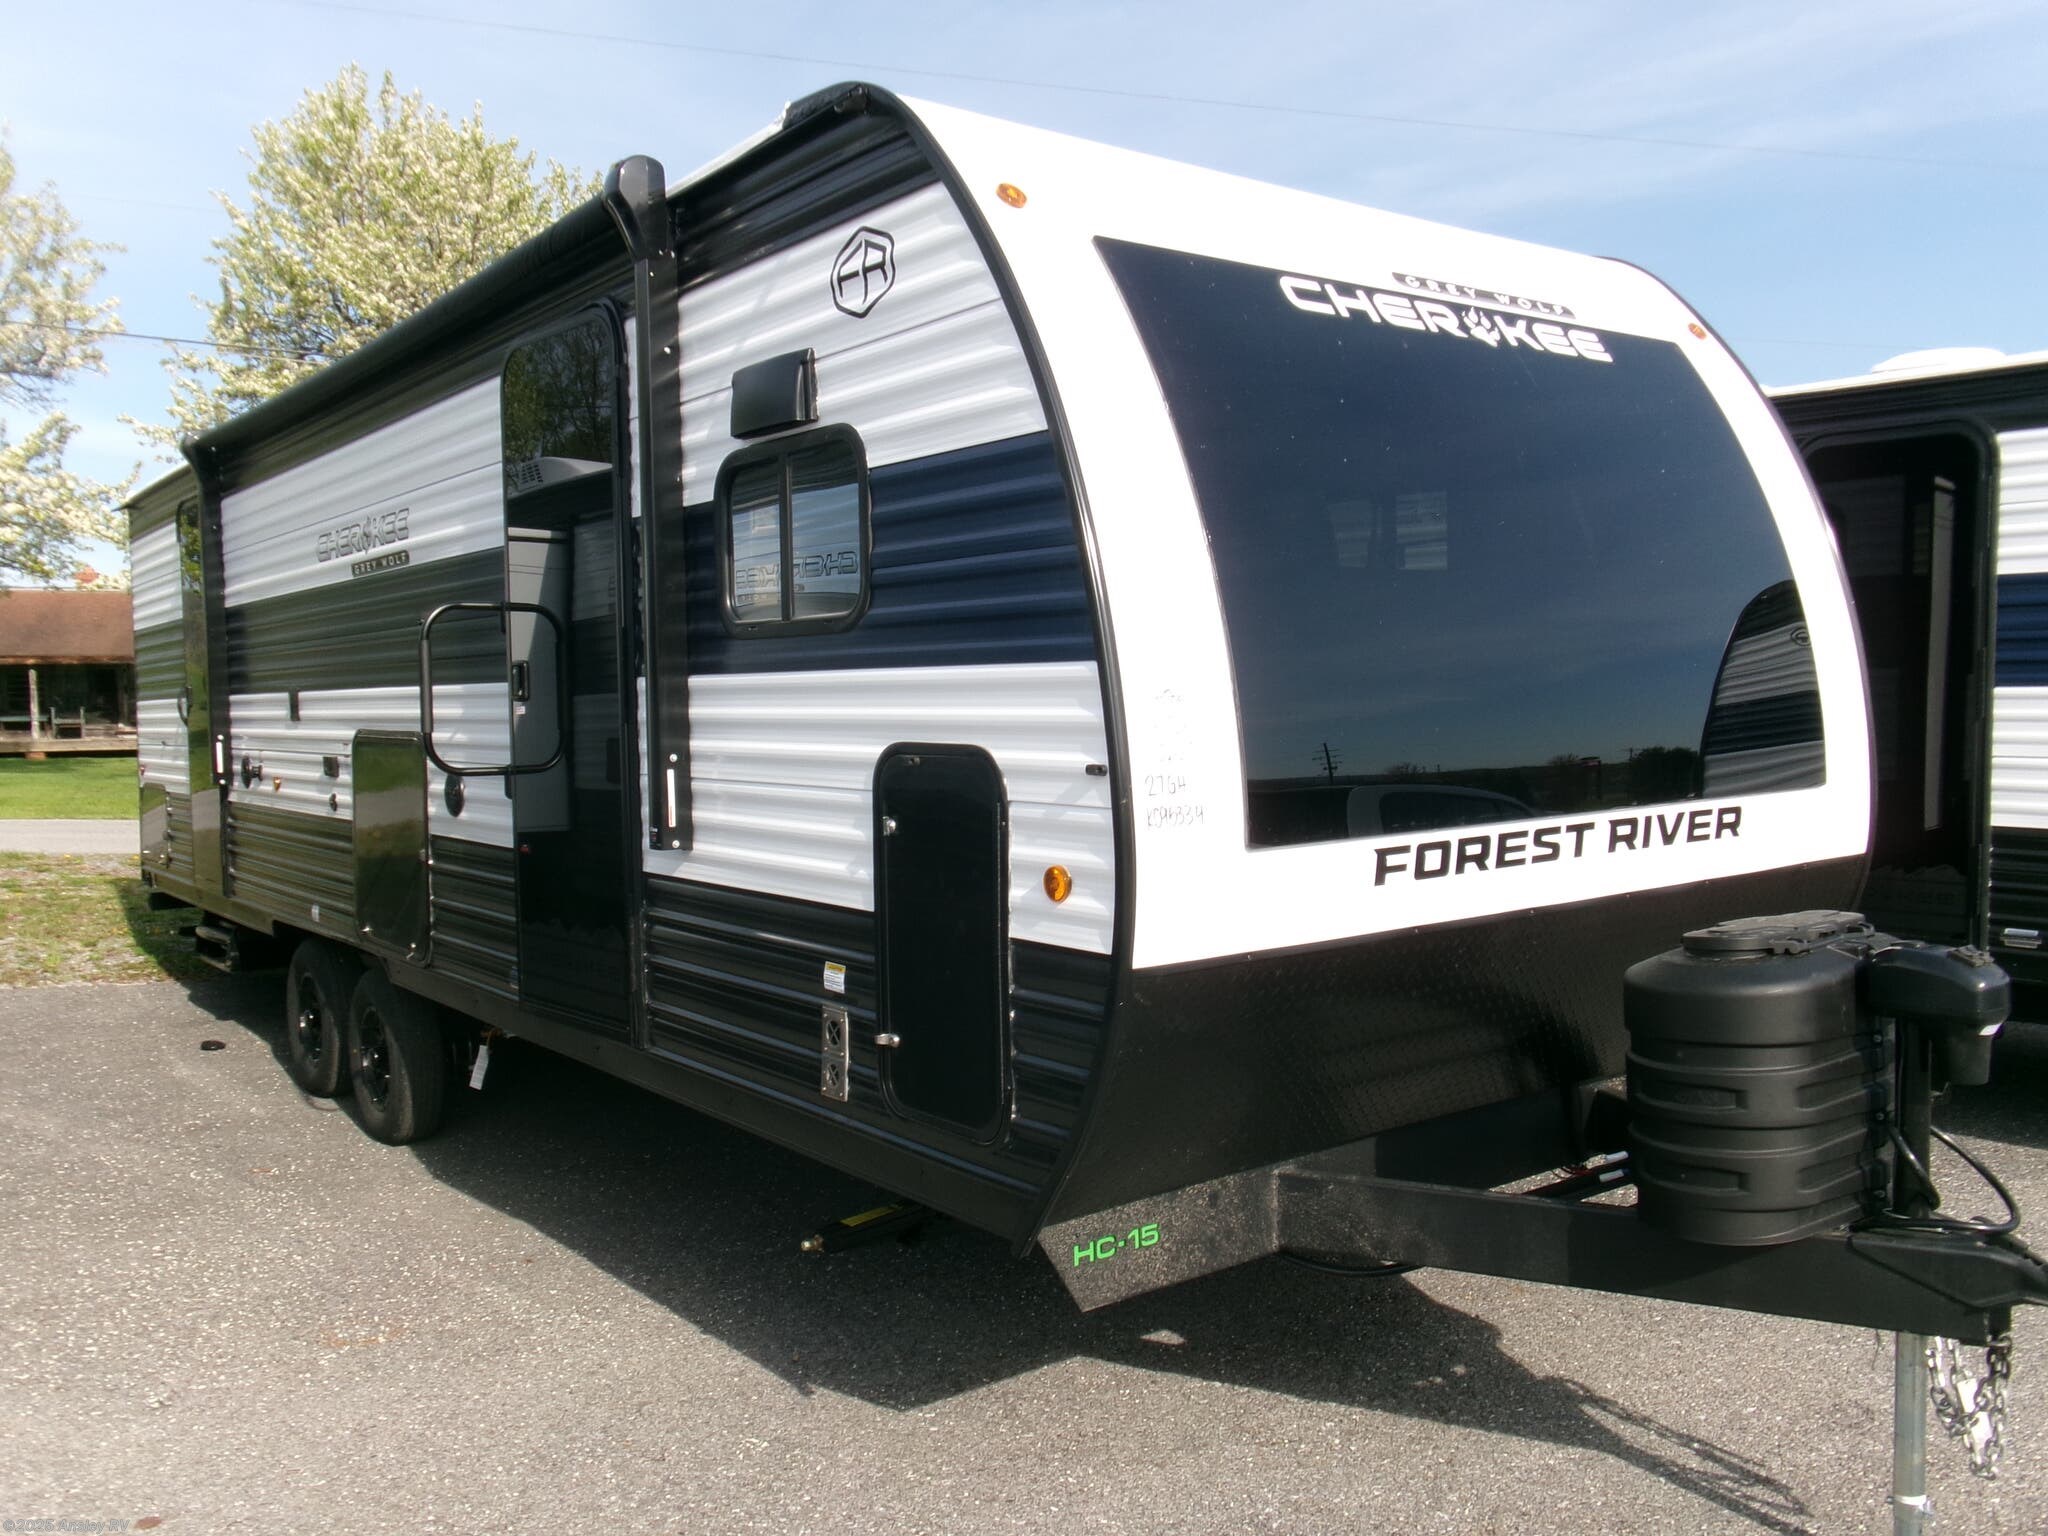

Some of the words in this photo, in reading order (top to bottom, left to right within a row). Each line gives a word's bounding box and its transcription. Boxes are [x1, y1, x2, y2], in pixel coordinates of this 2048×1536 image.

[1404, 275, 1477, 299] GREY
[1494, 292, 1565, 316] WOLF
[353, 561, 378, 575] GREY
[381, 552, 407, 567] WOLF
[1373, 821, 1597, 887] FOREST
[1607, 805, 1743, 853] RIVER
[1072, 1223, 1161, 1268] HC-15
